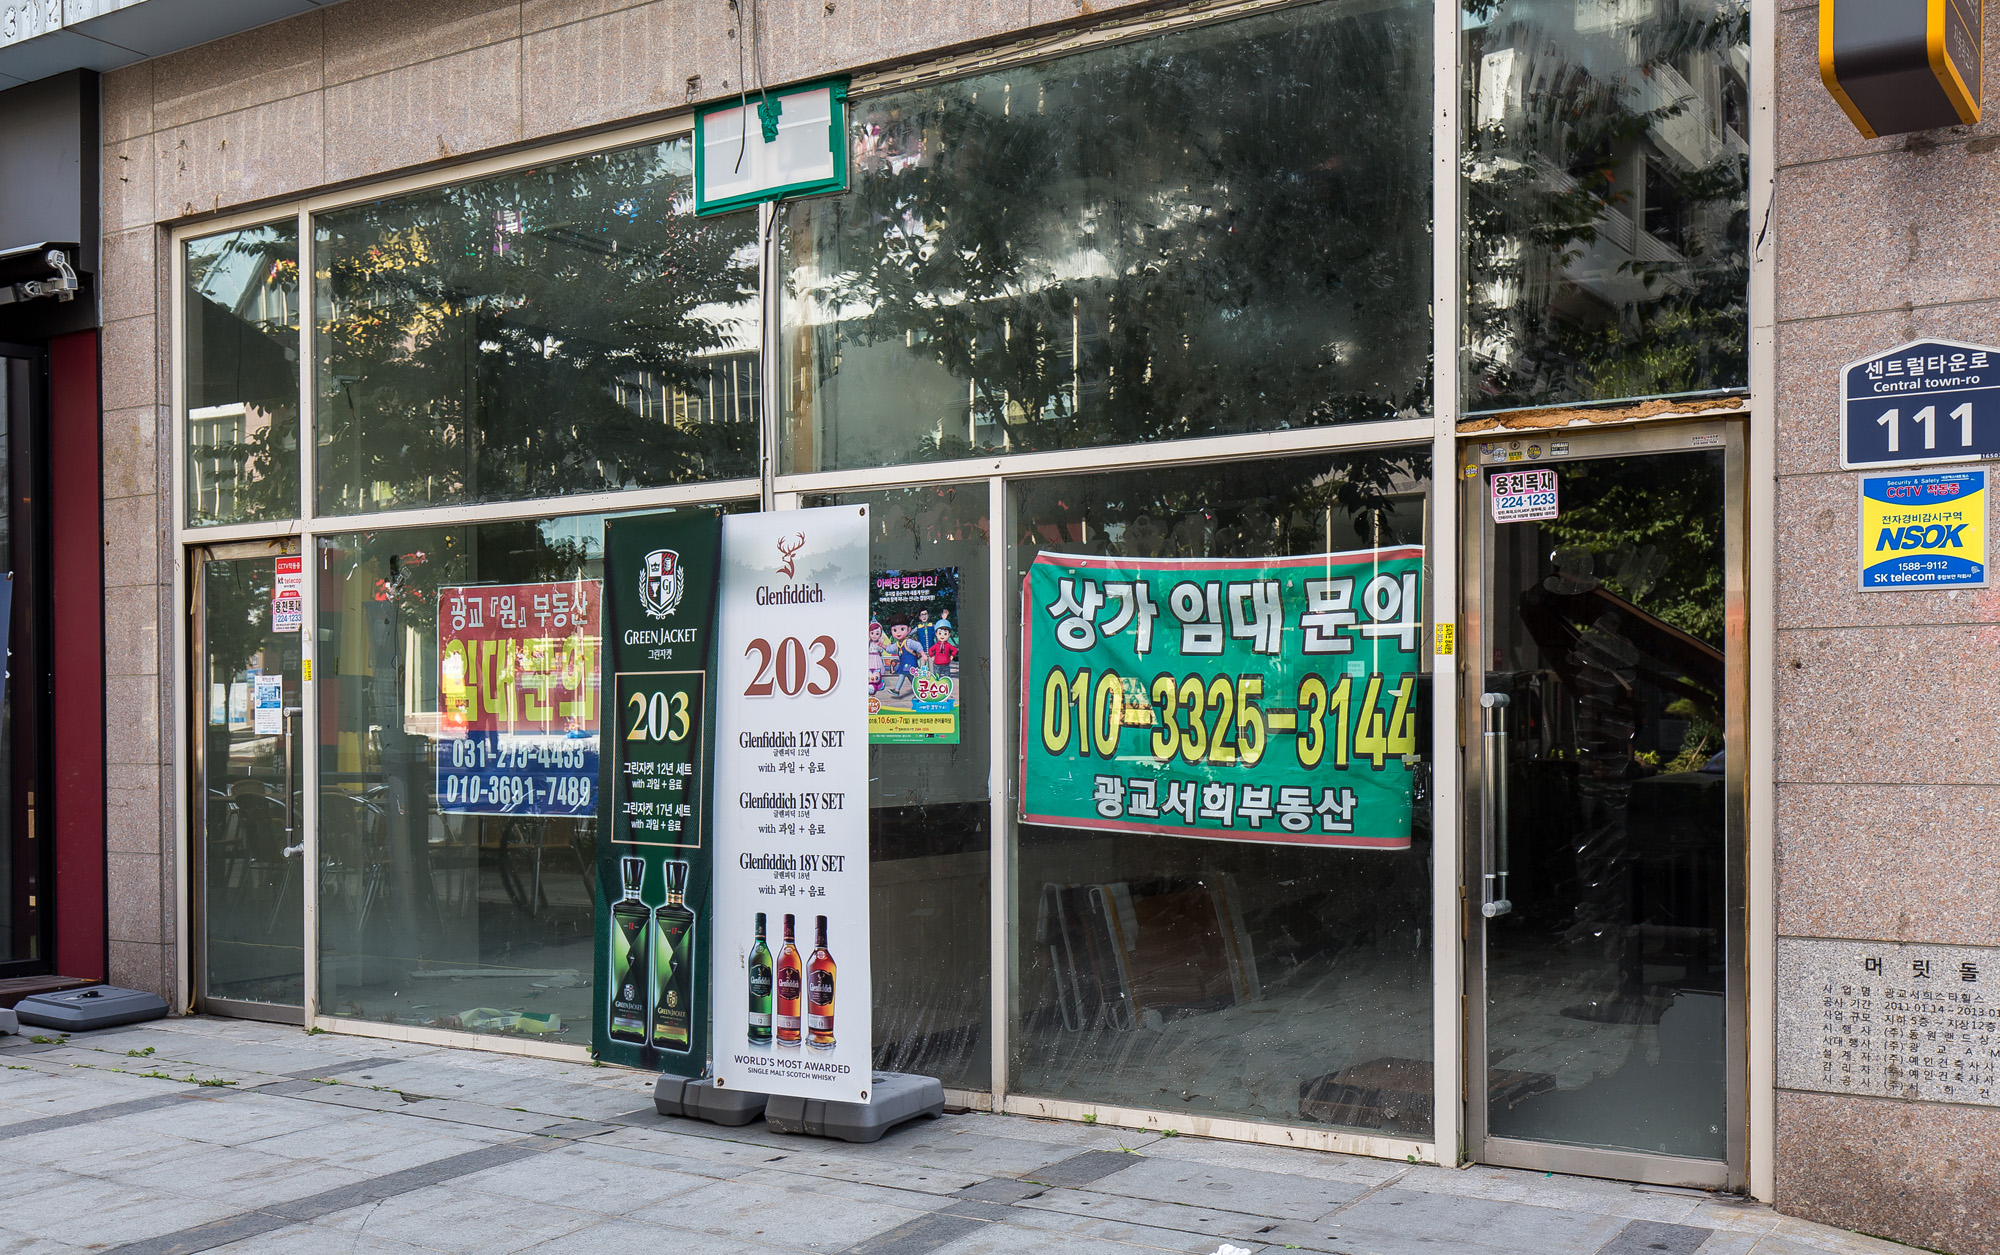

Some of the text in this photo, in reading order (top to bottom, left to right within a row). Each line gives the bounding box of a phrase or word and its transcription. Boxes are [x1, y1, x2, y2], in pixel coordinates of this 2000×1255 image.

[1865, 352, 1989, 380] 센트럴타운로
[1873, 375, 1980, 392] Central town-ro
[1876, 402, 1973, 452] 111
[1495, 471, 1555, 495] 용천목재
[1886, 483, 1960, 498] CCTV 작동중
[1882, 511, 1962, 525] 전자경비감시구역
[1875, 524, 1970, 551] NSOK
[1898, 561, 1948, 571] 1588-9112
[877, 576, 938, 590] 아빠랑 캠핑가요!
[1874, 574, 1888, 583] SK
[1891, 573, 1935, 582] telecom
[756, 583, 825, 606] Glenfiddich
[450, 597, 484, 631] 광교
[533, 591, 588, 628] 부동산
[1047, 578, 1159, 654] 상가
[1169, 579, 1285, 656] 임대
[1301, 570, 1418, 655] 문의
[648, 649, 672, 661] 그린자켓
[743, 635, 839, 697] 203
[444, 634, 594, 722] 임대문의
[918, 680, 949, 699] 콩순이
[626, 691, 690, 742] 203
[1041, 664, 1416, 771] 010-3325-3144
[739, 731, 844, 748] Glenfiddich 12Y SET
[623, 762, 692, 776] 그린자켓 12년 세트
[758, 763, 776, 772] with
[778, 762, 795, 774] 과일
[808, 762, 825, 773] 음료
[447, 775, 591, 806] 010-3691-7489
[632, 779, 645, 788] with
[646, 778, 660, 789] 과일
[669, 779, 682, 790] 음료
[622, 802, 691, 817] 그린자켓 17년 세트
[739, 792, 845, 810] Glenfiddich 15Y SET
[1093, 774, 1358, 833] 광교서희부동산
[631, 819, 644, 829] with
[645, 819, 659, 830] 과일
[667, 819, 681, 831] 음료
[758, 824, 776, 833] with
[778, 823, 795, 835] 과일
[808, 823, 826, 836] 음료
[739, 853, 845, 872] Glenfiddich 18Y SET
[758, 885, 776, 895] with
[778, 884, 795, 896] 과일
[808, 885, 826, 897] 음료
[628, 922, 635, 930] 12
[734, 1055, 850, 1074] WORLD'S MOST AWARDED
[748, 1067, 836, 1081] SINGLE MALT SCOTCH WHISKY
